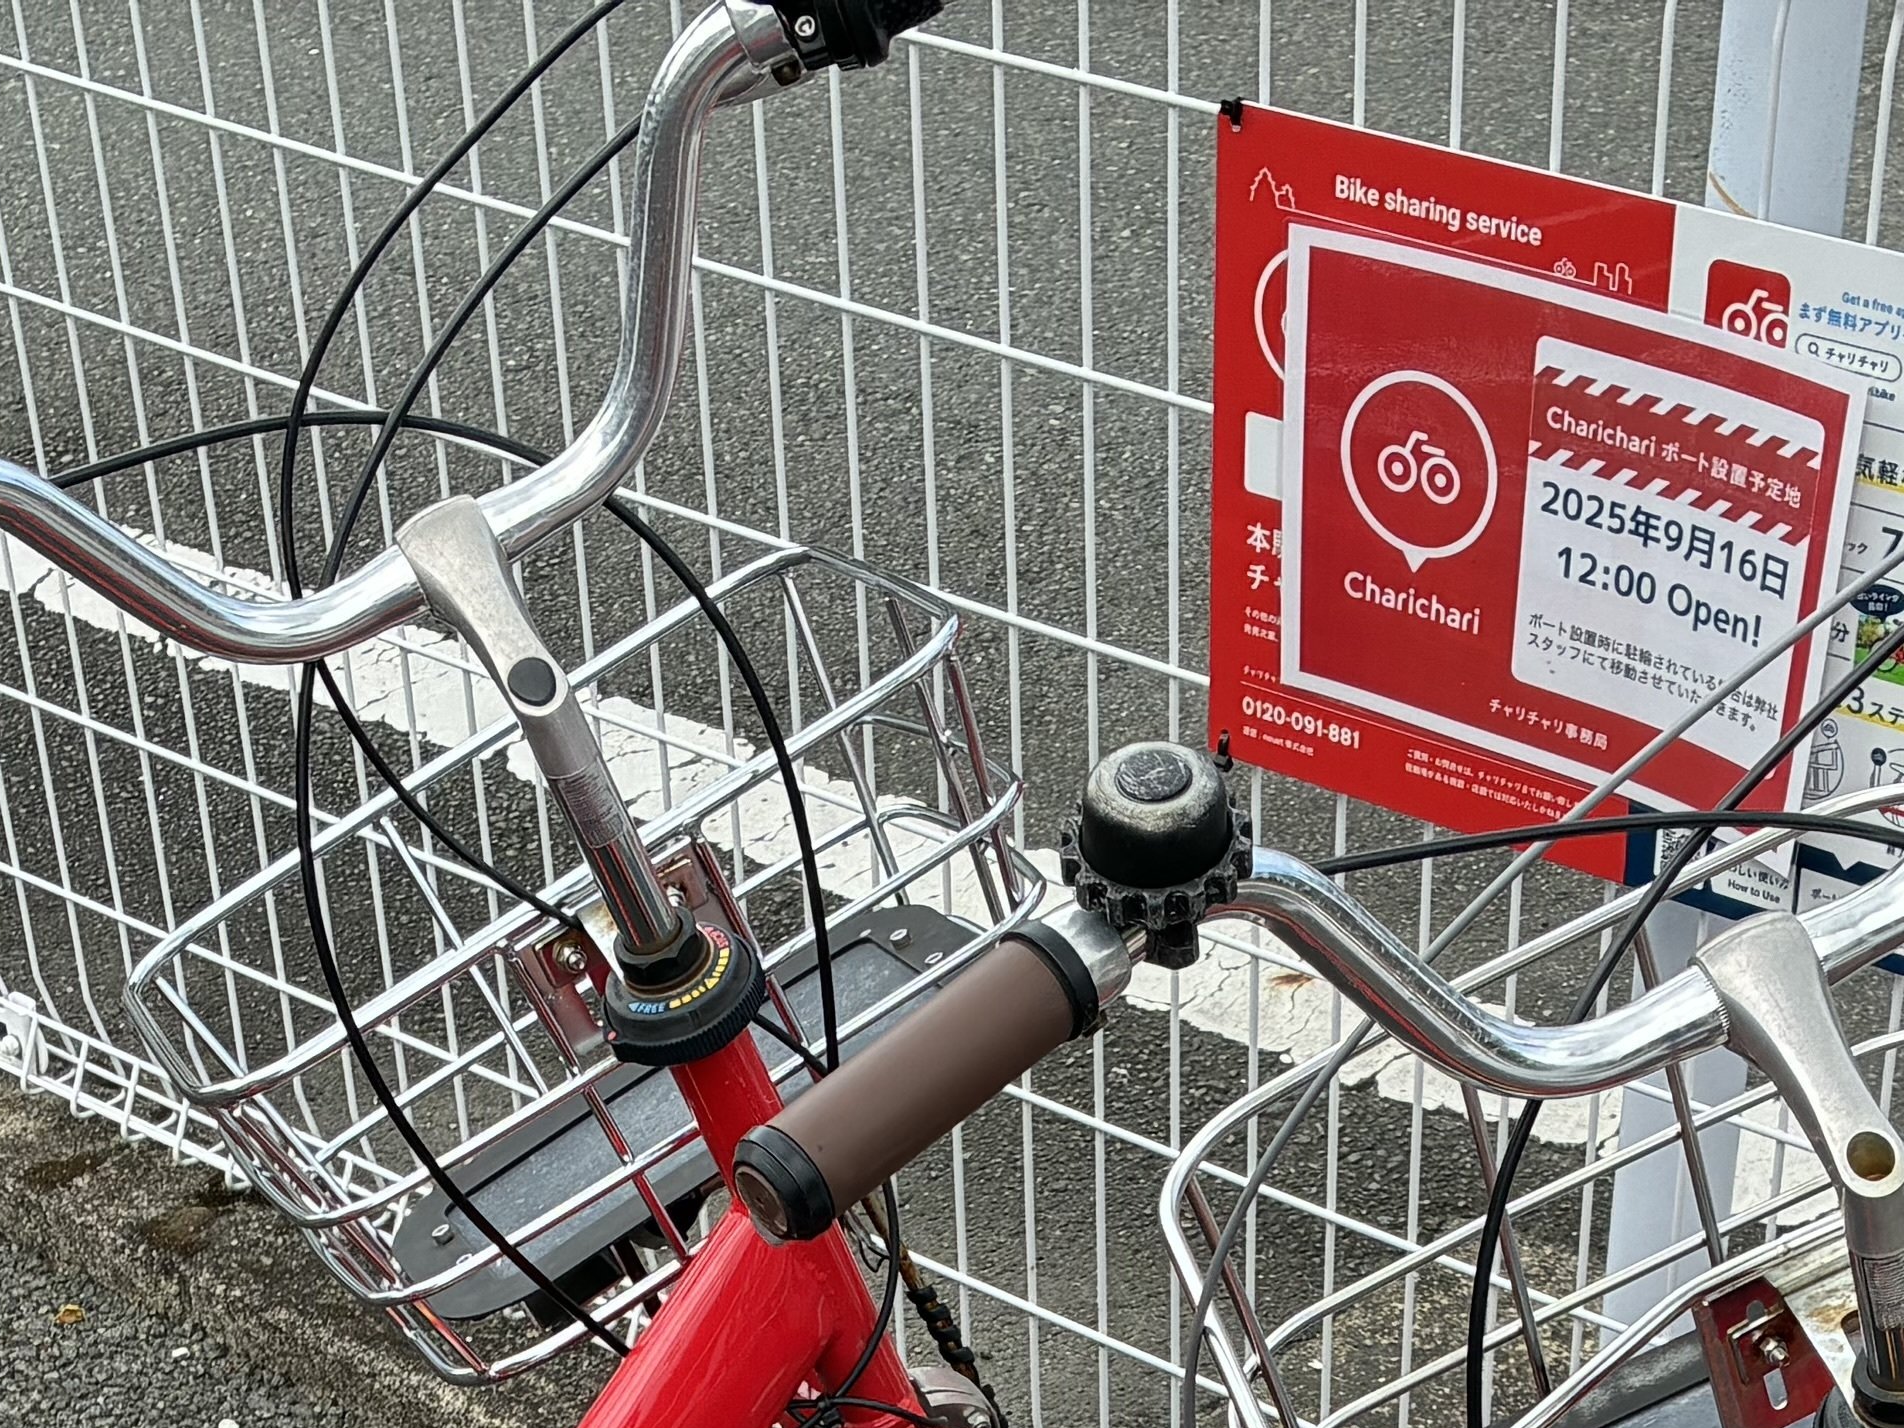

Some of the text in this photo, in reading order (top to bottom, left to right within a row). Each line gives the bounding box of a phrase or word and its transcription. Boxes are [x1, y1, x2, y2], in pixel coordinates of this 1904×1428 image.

[1335, 174, 1542, 246] Bike sharing service
[1842, 291, 1862, 307] Get
[1872, 297, 1894, 315] free
[1825, 347, 1890, 373] チャリチャリ
[1545, 405, 1802, 509] Charichari ポート設置予定地
[1540, 480, 1790, 600] 2025年9月16日
[1343, 571, 1481, 636] Charichari
[1557, 546, 1763, 649] 12:00 Open!
[1527, 632, 1758, 733] スタッフにて移動させていたきます。
[1529, 612, 1779, 722] ポート設置時に駐輪されている合は弊社
[1241, 696, 1361, 750] 0120-091-881
[1489, 698, 1609, 750] チャリチャリ事務局
[1728, 879, 1781, 904] How to Use
